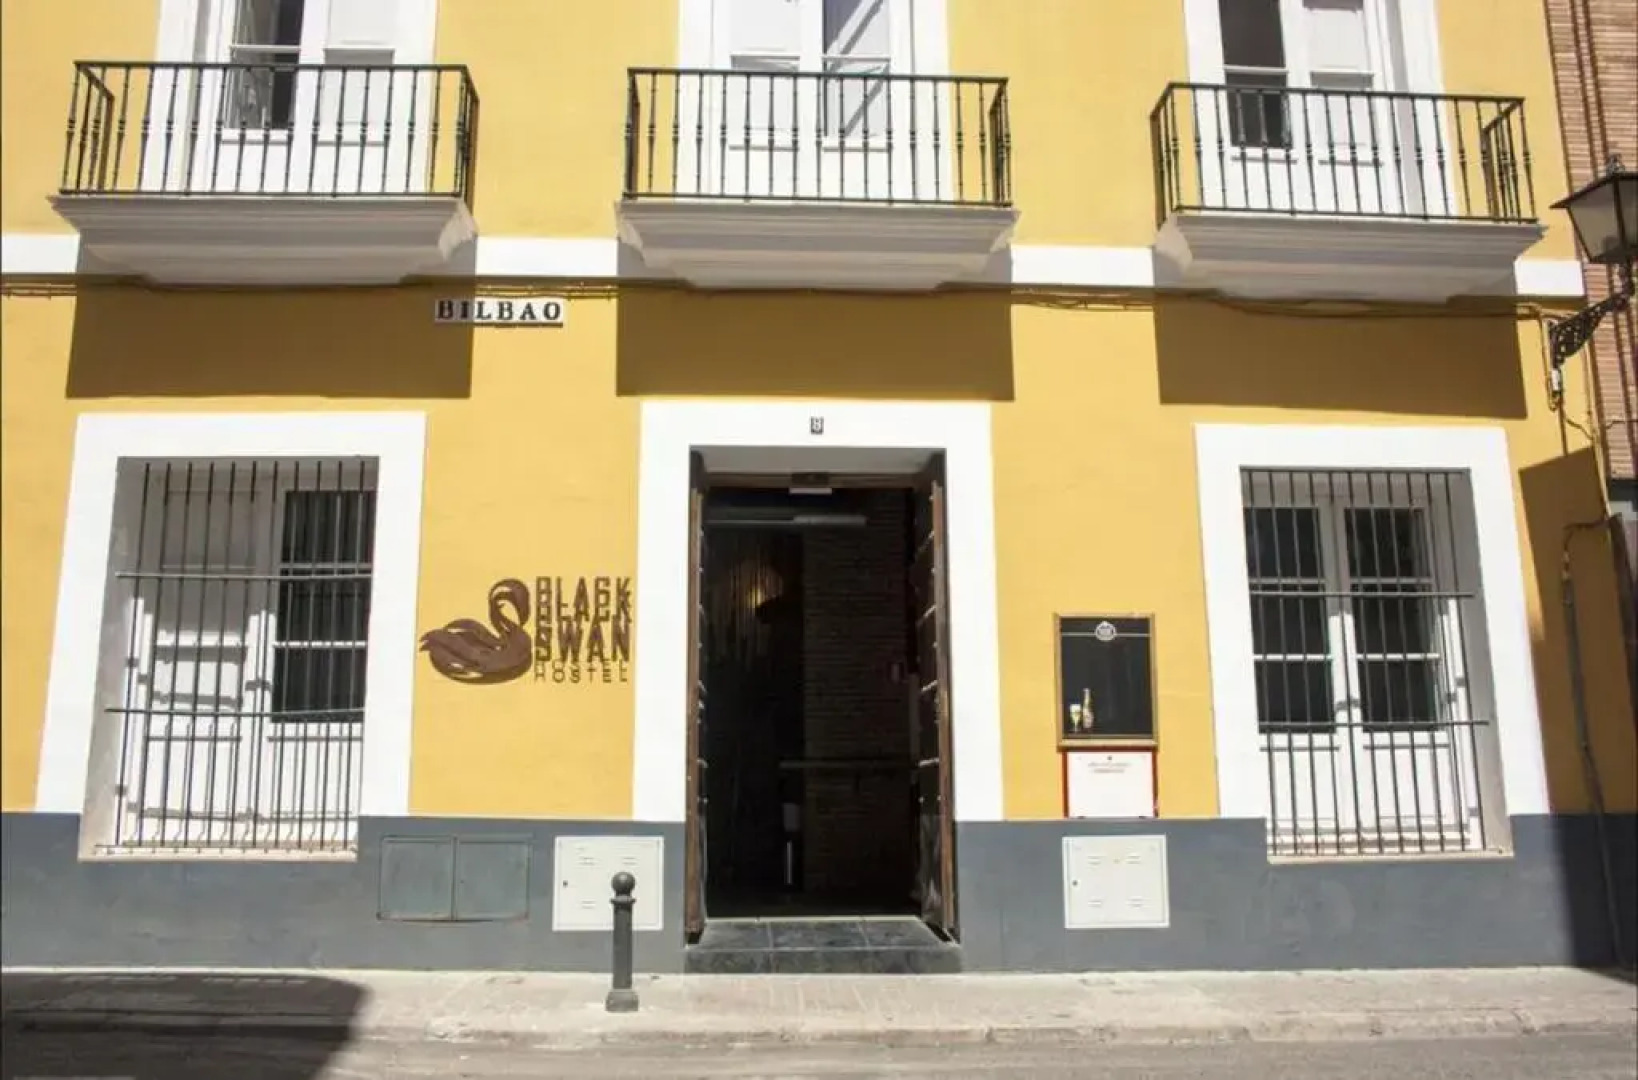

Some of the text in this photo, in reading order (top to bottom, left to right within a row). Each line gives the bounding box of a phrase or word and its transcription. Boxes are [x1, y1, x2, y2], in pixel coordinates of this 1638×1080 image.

[438, 300, 561, 321] BILBAO
[535, 576, 630, 618] BLACK
[535, 615, 630, 661] SWAN
[534, 659, 628, 682] HOSTEL
